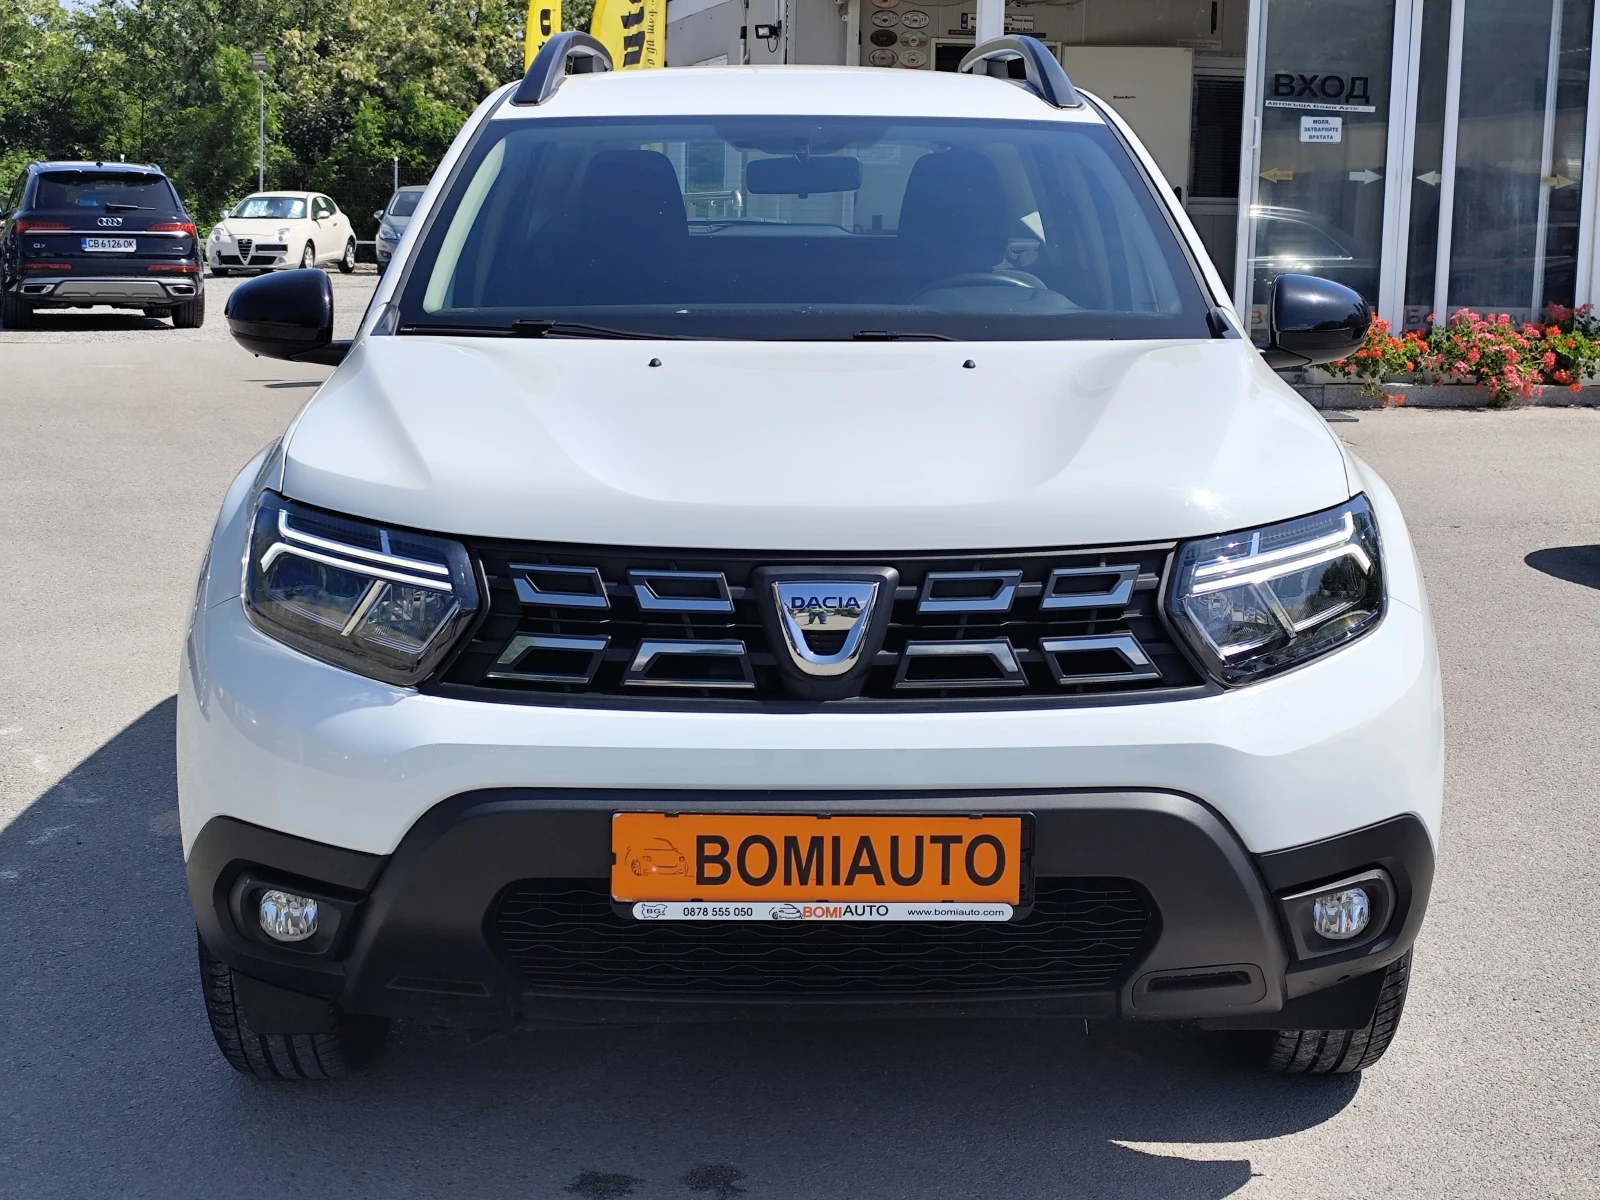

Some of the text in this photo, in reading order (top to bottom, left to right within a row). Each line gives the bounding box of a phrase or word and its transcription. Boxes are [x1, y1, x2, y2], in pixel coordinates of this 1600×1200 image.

[1274, 74, 1370, 104] ВХОД
[88, 240, 99, 248] CB
[101, 240, 122, 248] 6126
[791, 597, 860, 608] DACIA
[696, 834, 1006, 887] BOMIAUTO
[683, 907, 753, 917] 0878 555 050
[802, 905, 889, 918] BOMIAUTO
[907, 908, 1005, 916] www.bomiauto.com
